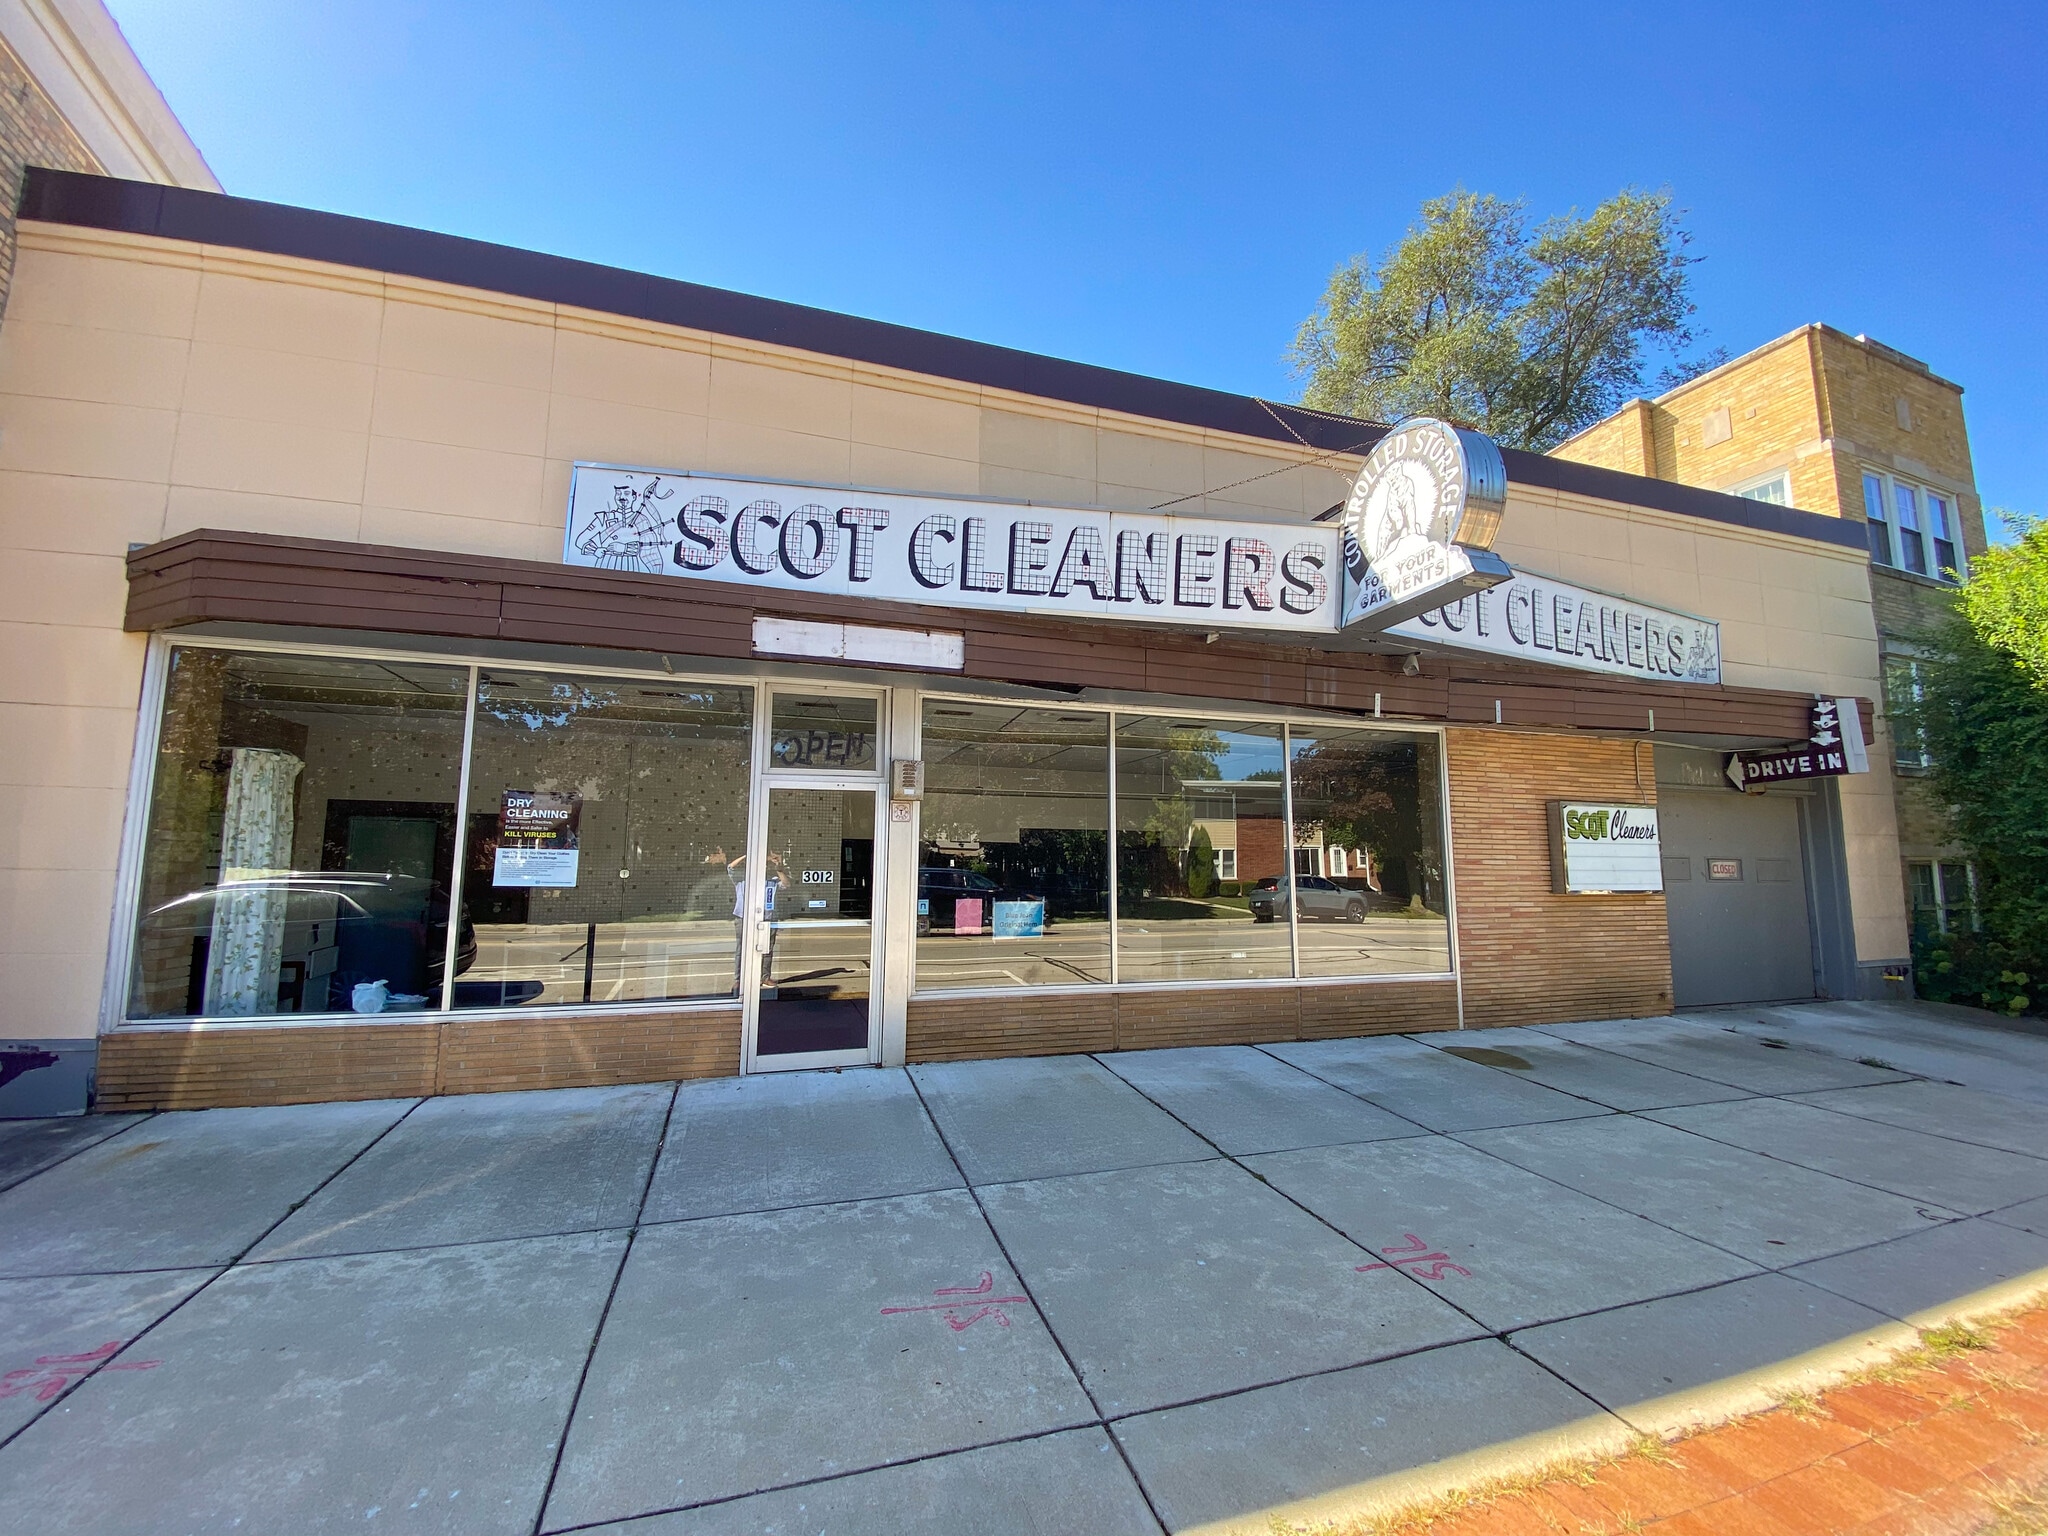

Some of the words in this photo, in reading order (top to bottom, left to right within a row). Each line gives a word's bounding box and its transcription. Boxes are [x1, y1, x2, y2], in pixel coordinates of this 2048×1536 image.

[1344, 433, 1408, 568] CONTROLLED
[1412, 429, 1461, 519] STORAGE
[673, 495, 889, 582] SCOT
[908, 513, 1328, 615] CLEANERS
[1364, 568, 1388, 591] FOR
[1396, 544, 1436, 575] YOUR
[1360, 558, 1445, 609] GARMENTS
[1506, 584, 1686, 677] CLEANERS
[779, 730, 865, 766] OPEN
[1747, 755, 1812, 778] DRIVE
[1817, 752, 1842, 770] IN
[506, 808, 568, 819] CLEANING
[507, 798, 533, 807] DRY
[504, 830, 522, 838] KILL
[523, 831, 557, 839] VIRUSES
[1566, 810, 1610, 841] SCOT
[1610, 810, 1657, 841] Cleaners
[803, 871, 833, 883] 3012
[1712, 864, 1737, 875] CLOSED
